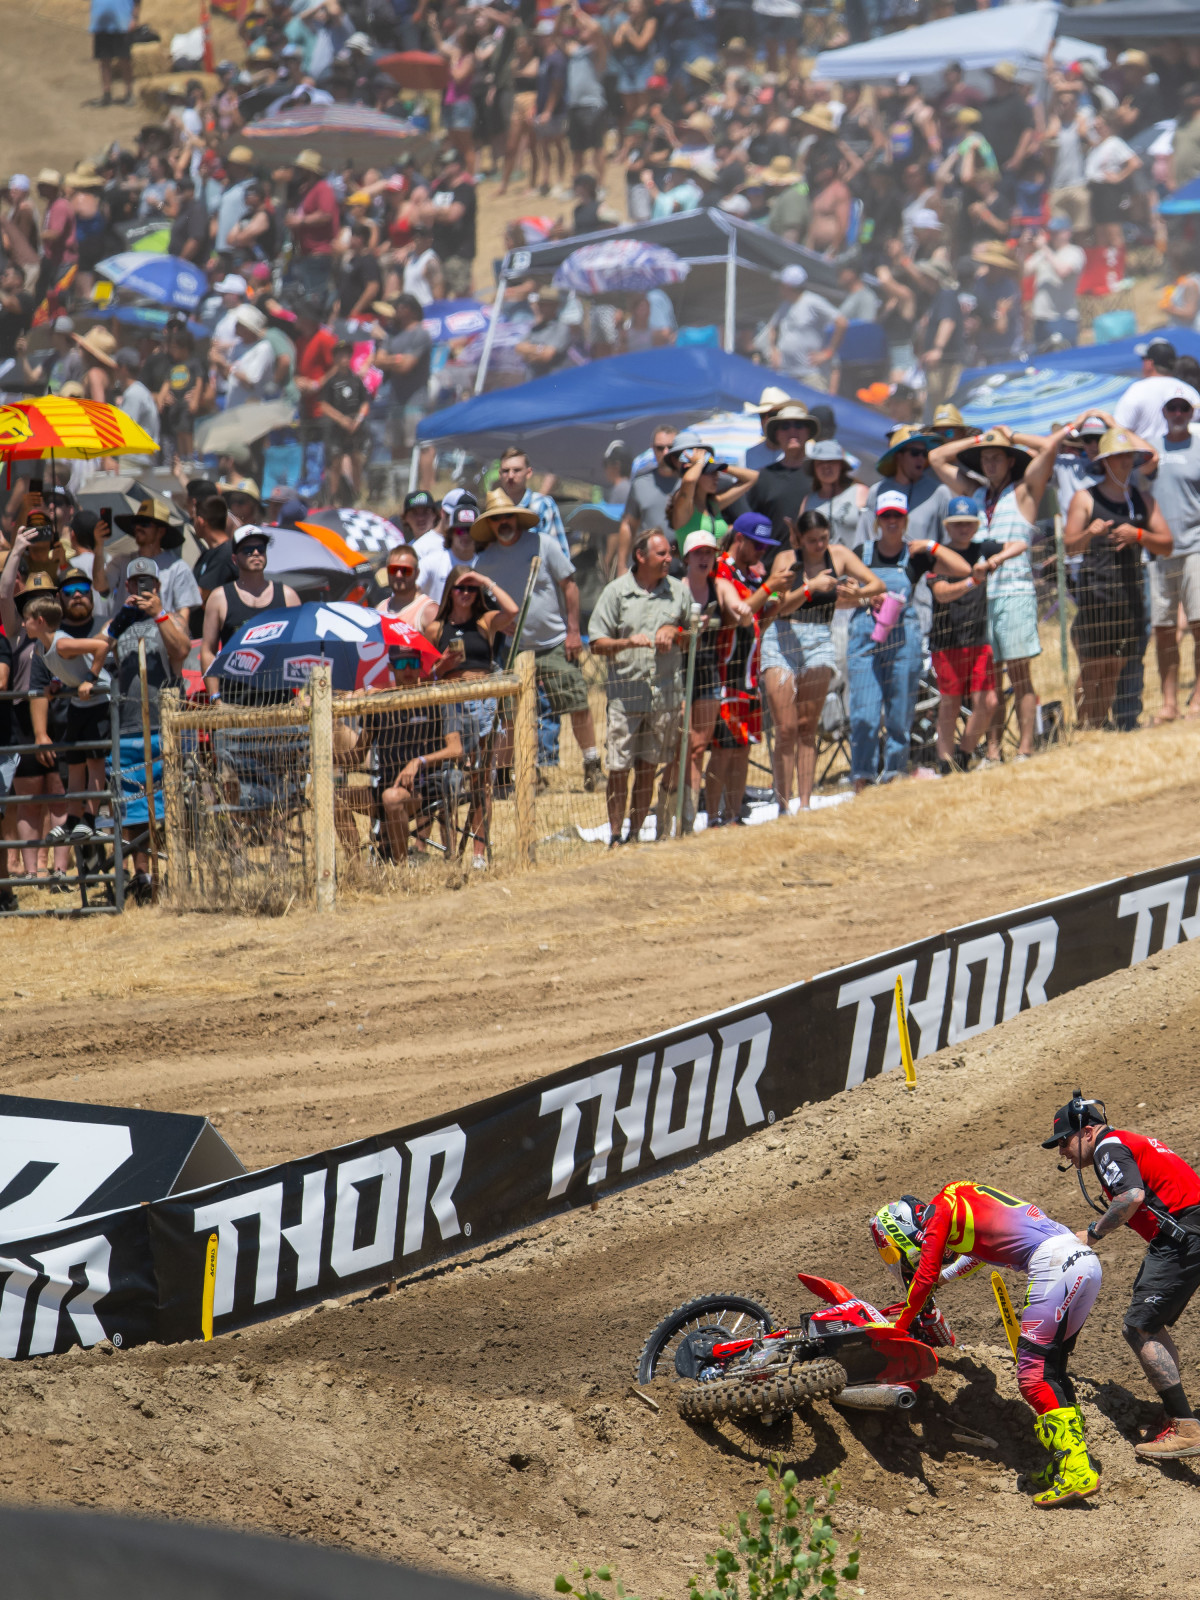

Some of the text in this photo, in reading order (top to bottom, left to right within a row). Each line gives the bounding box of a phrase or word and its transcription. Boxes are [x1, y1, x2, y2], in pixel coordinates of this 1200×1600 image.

[837, 916, 1059, 1090] THOR
[539, 1012, 772, 1200] THOR
[194, 1123, 467, 1317] THOR
[997, 1286, 1013, 1327] ACERBIS
[1061, 1276, 1083, 1311] HONDA
